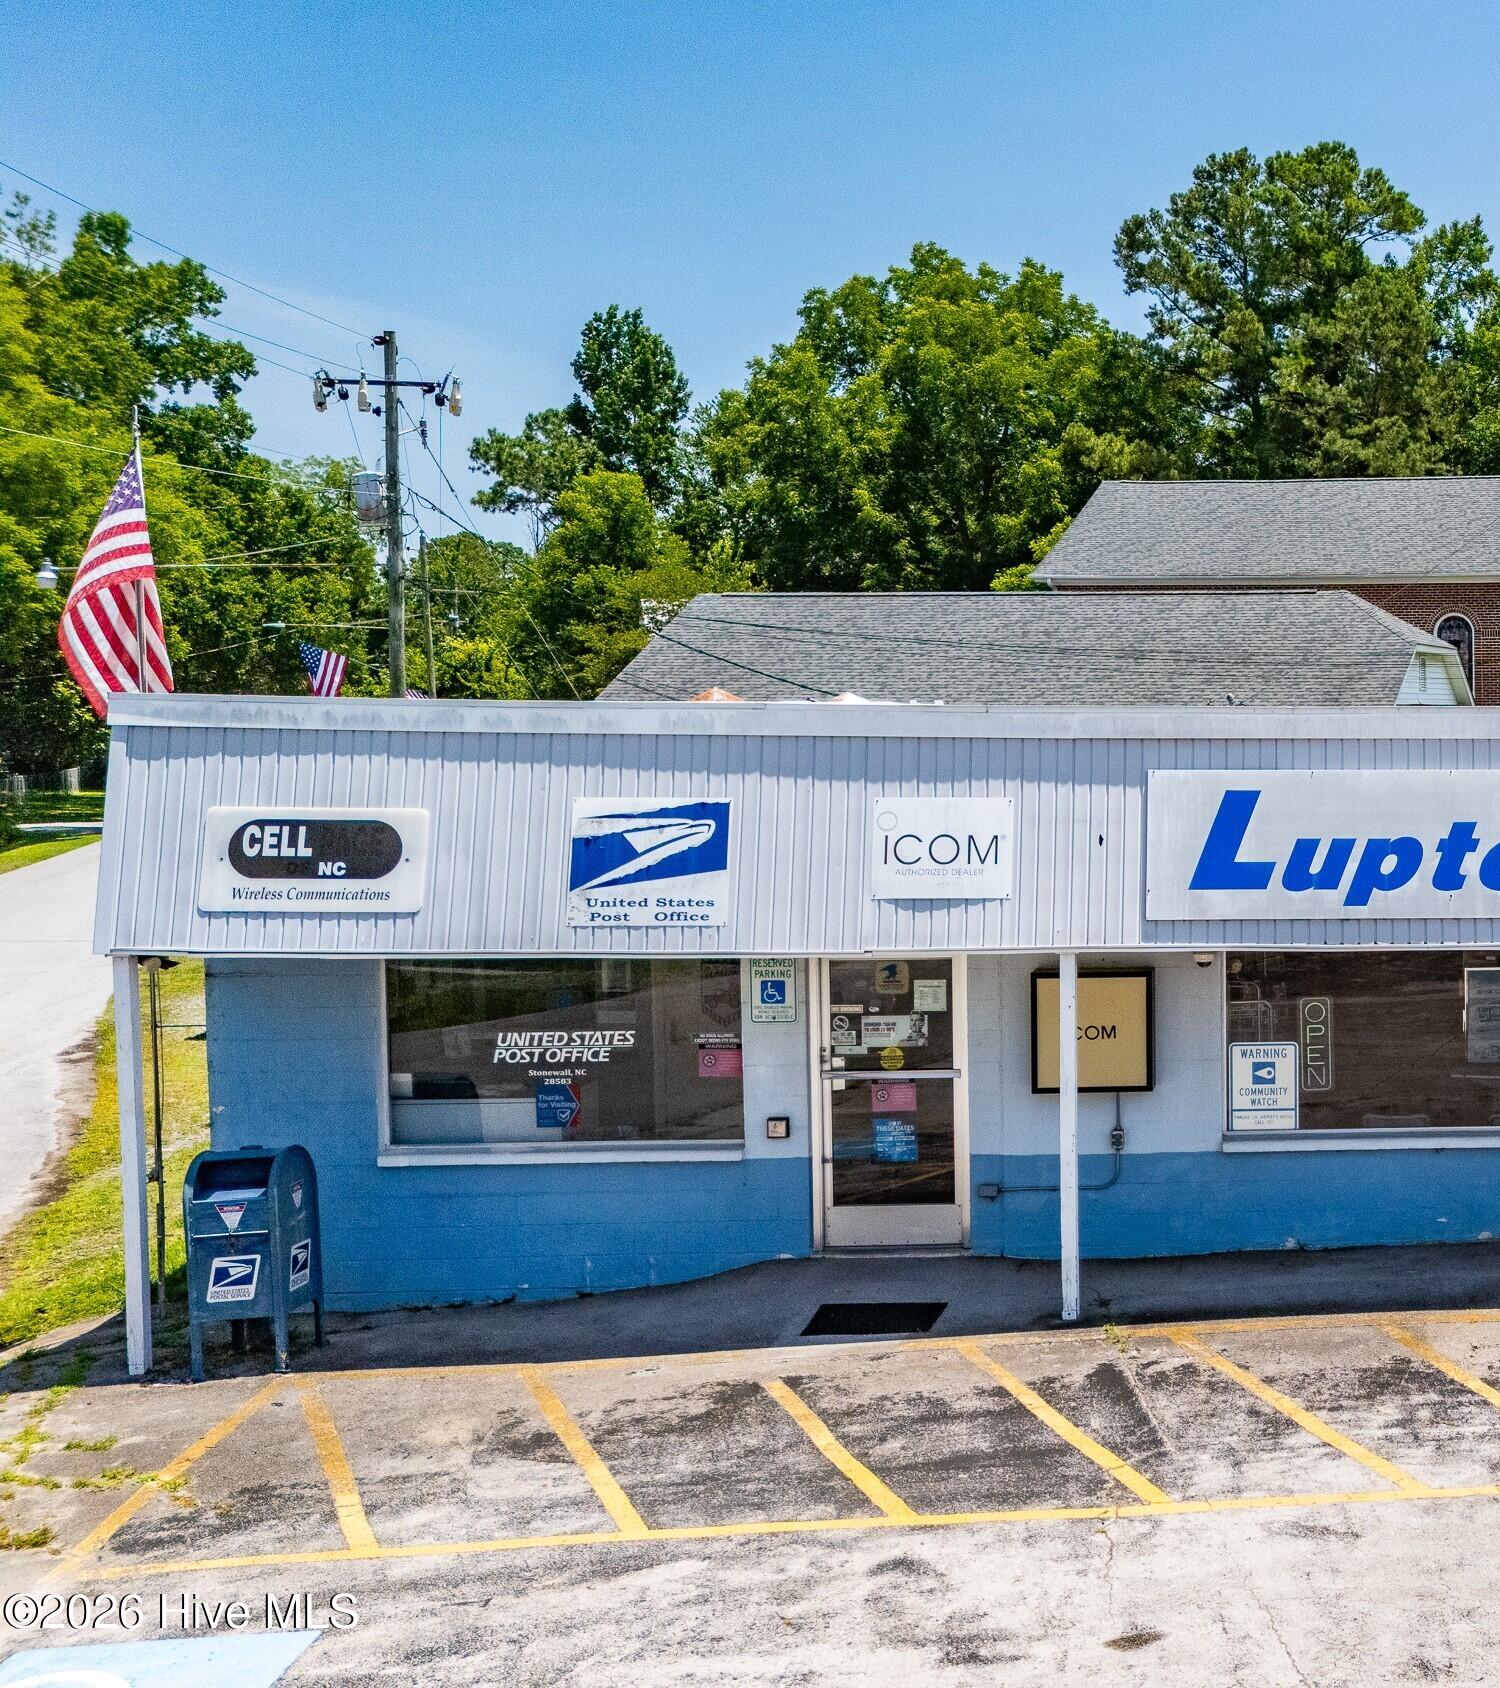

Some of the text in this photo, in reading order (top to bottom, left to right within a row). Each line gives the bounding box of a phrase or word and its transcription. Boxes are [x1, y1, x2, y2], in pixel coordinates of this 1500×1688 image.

[242, 825, 313, 857] CELL
[317, 862, 347, 876] NC
[895, 868, 984, 876] AUTHORIZED DEALER
[231, 887, 391, 901] Wireless Communications
[586, 897, 715, 908] United States
[589, 911, 710, 922] Post Office
[752, 958, 794, 968] RESERVED
[754, 969, 792, 979] PARKING
[496, 1030, 636, 1047] UNITED STATES
[1305, 1002, 1326, 1086] OPEN
[493, 1047, 612, 1063] POST OFFICE
[1239, 1048, 1288, 1059] WARNING
[528, 1068, 587, 1077] Stonewall, NC
[1239, 1087, 1288, 1096] COMMUNITY
[550, 1101, 576, 1109] Visiting
[1250, 1097, 1278, 1106] WATCH
